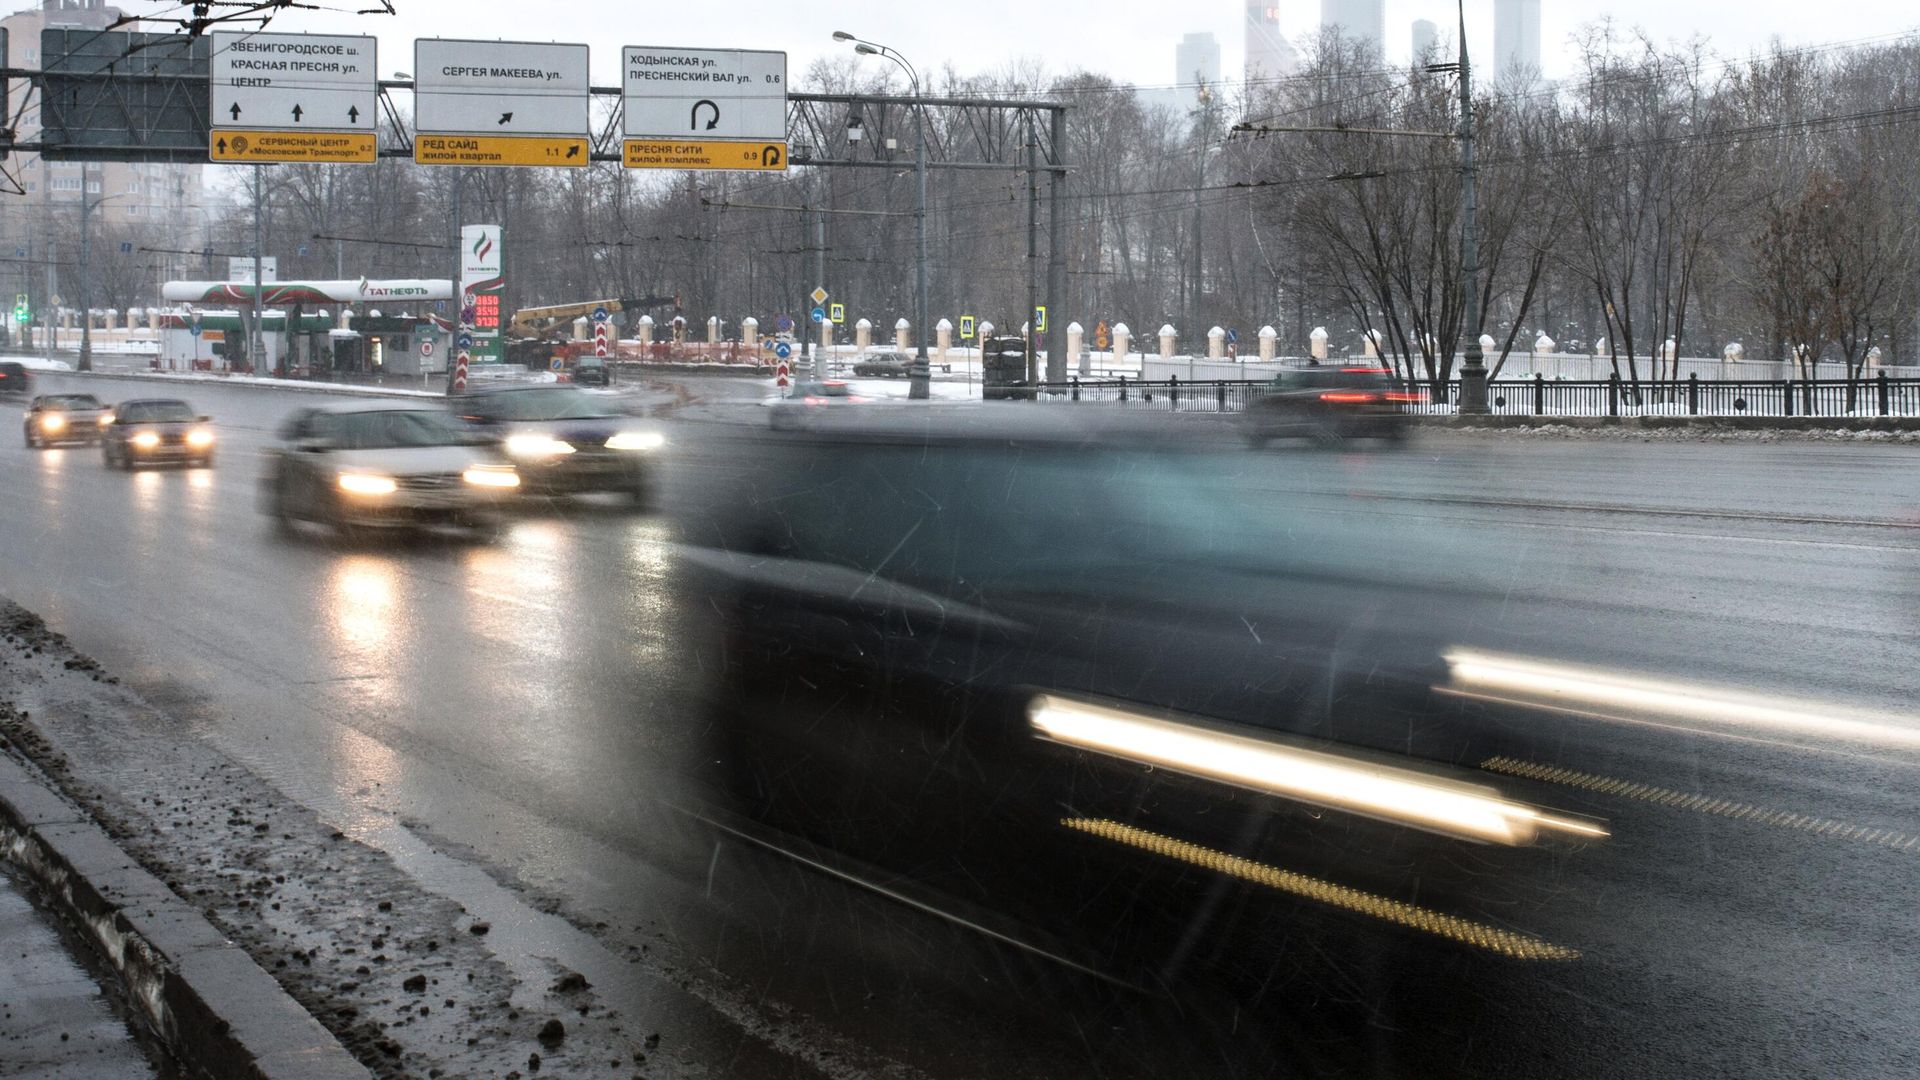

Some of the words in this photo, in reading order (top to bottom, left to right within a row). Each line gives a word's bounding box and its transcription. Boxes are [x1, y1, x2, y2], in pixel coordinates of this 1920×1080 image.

[230, 42, 343, 56] ЗВЕНИГОРОДСКОЕ
[231, 60, 287, 71] КРАСНАЯ
[290, 61, 339, 72] ПРЕСНЯ
[342, 64, 359, 75] ул.
[630, 55, 699, 67] ХОДЫНСКАЯ
[702, 59, 717, 69] ул.
[442, 67, 487, 77] СЕРГЕЯ
[490, 68, 544, 78] МАКЕЕВА
[546, 71, 562, 81] ул.
[630, 70, 709, 82] ПРЕСНЕНСКИЙ
[713, 73, 734, 82] ВАЛ
[737, 75, 752, 84] ул.
[765, 74, 780, 83] 0.6
[231, 77, 271, 88] ЦЕНТР
[259, 137, 318, 147] СЕРВИСНЫЙ
[320, 138, 350, 148] ЦЕНТР
[422, 140, 445, 150] РЕД
[448, 140, 478, 151] САЙД
[545, 148, 559, 156] 1.1
[629, 144, 672, 154] ПРЕСНЯ
[674, 145, 703, 154] СИТИ
[422, 150, 457, 160] жилой
[460, 153, 502, 163] квартал
[629, 155, 662, 164] жилой
[664, 157, 711, 166] комплекс
[743, 152, 758, 160] 0.9
[369, 287, 428, 296] ТАТНЕФТЬ
